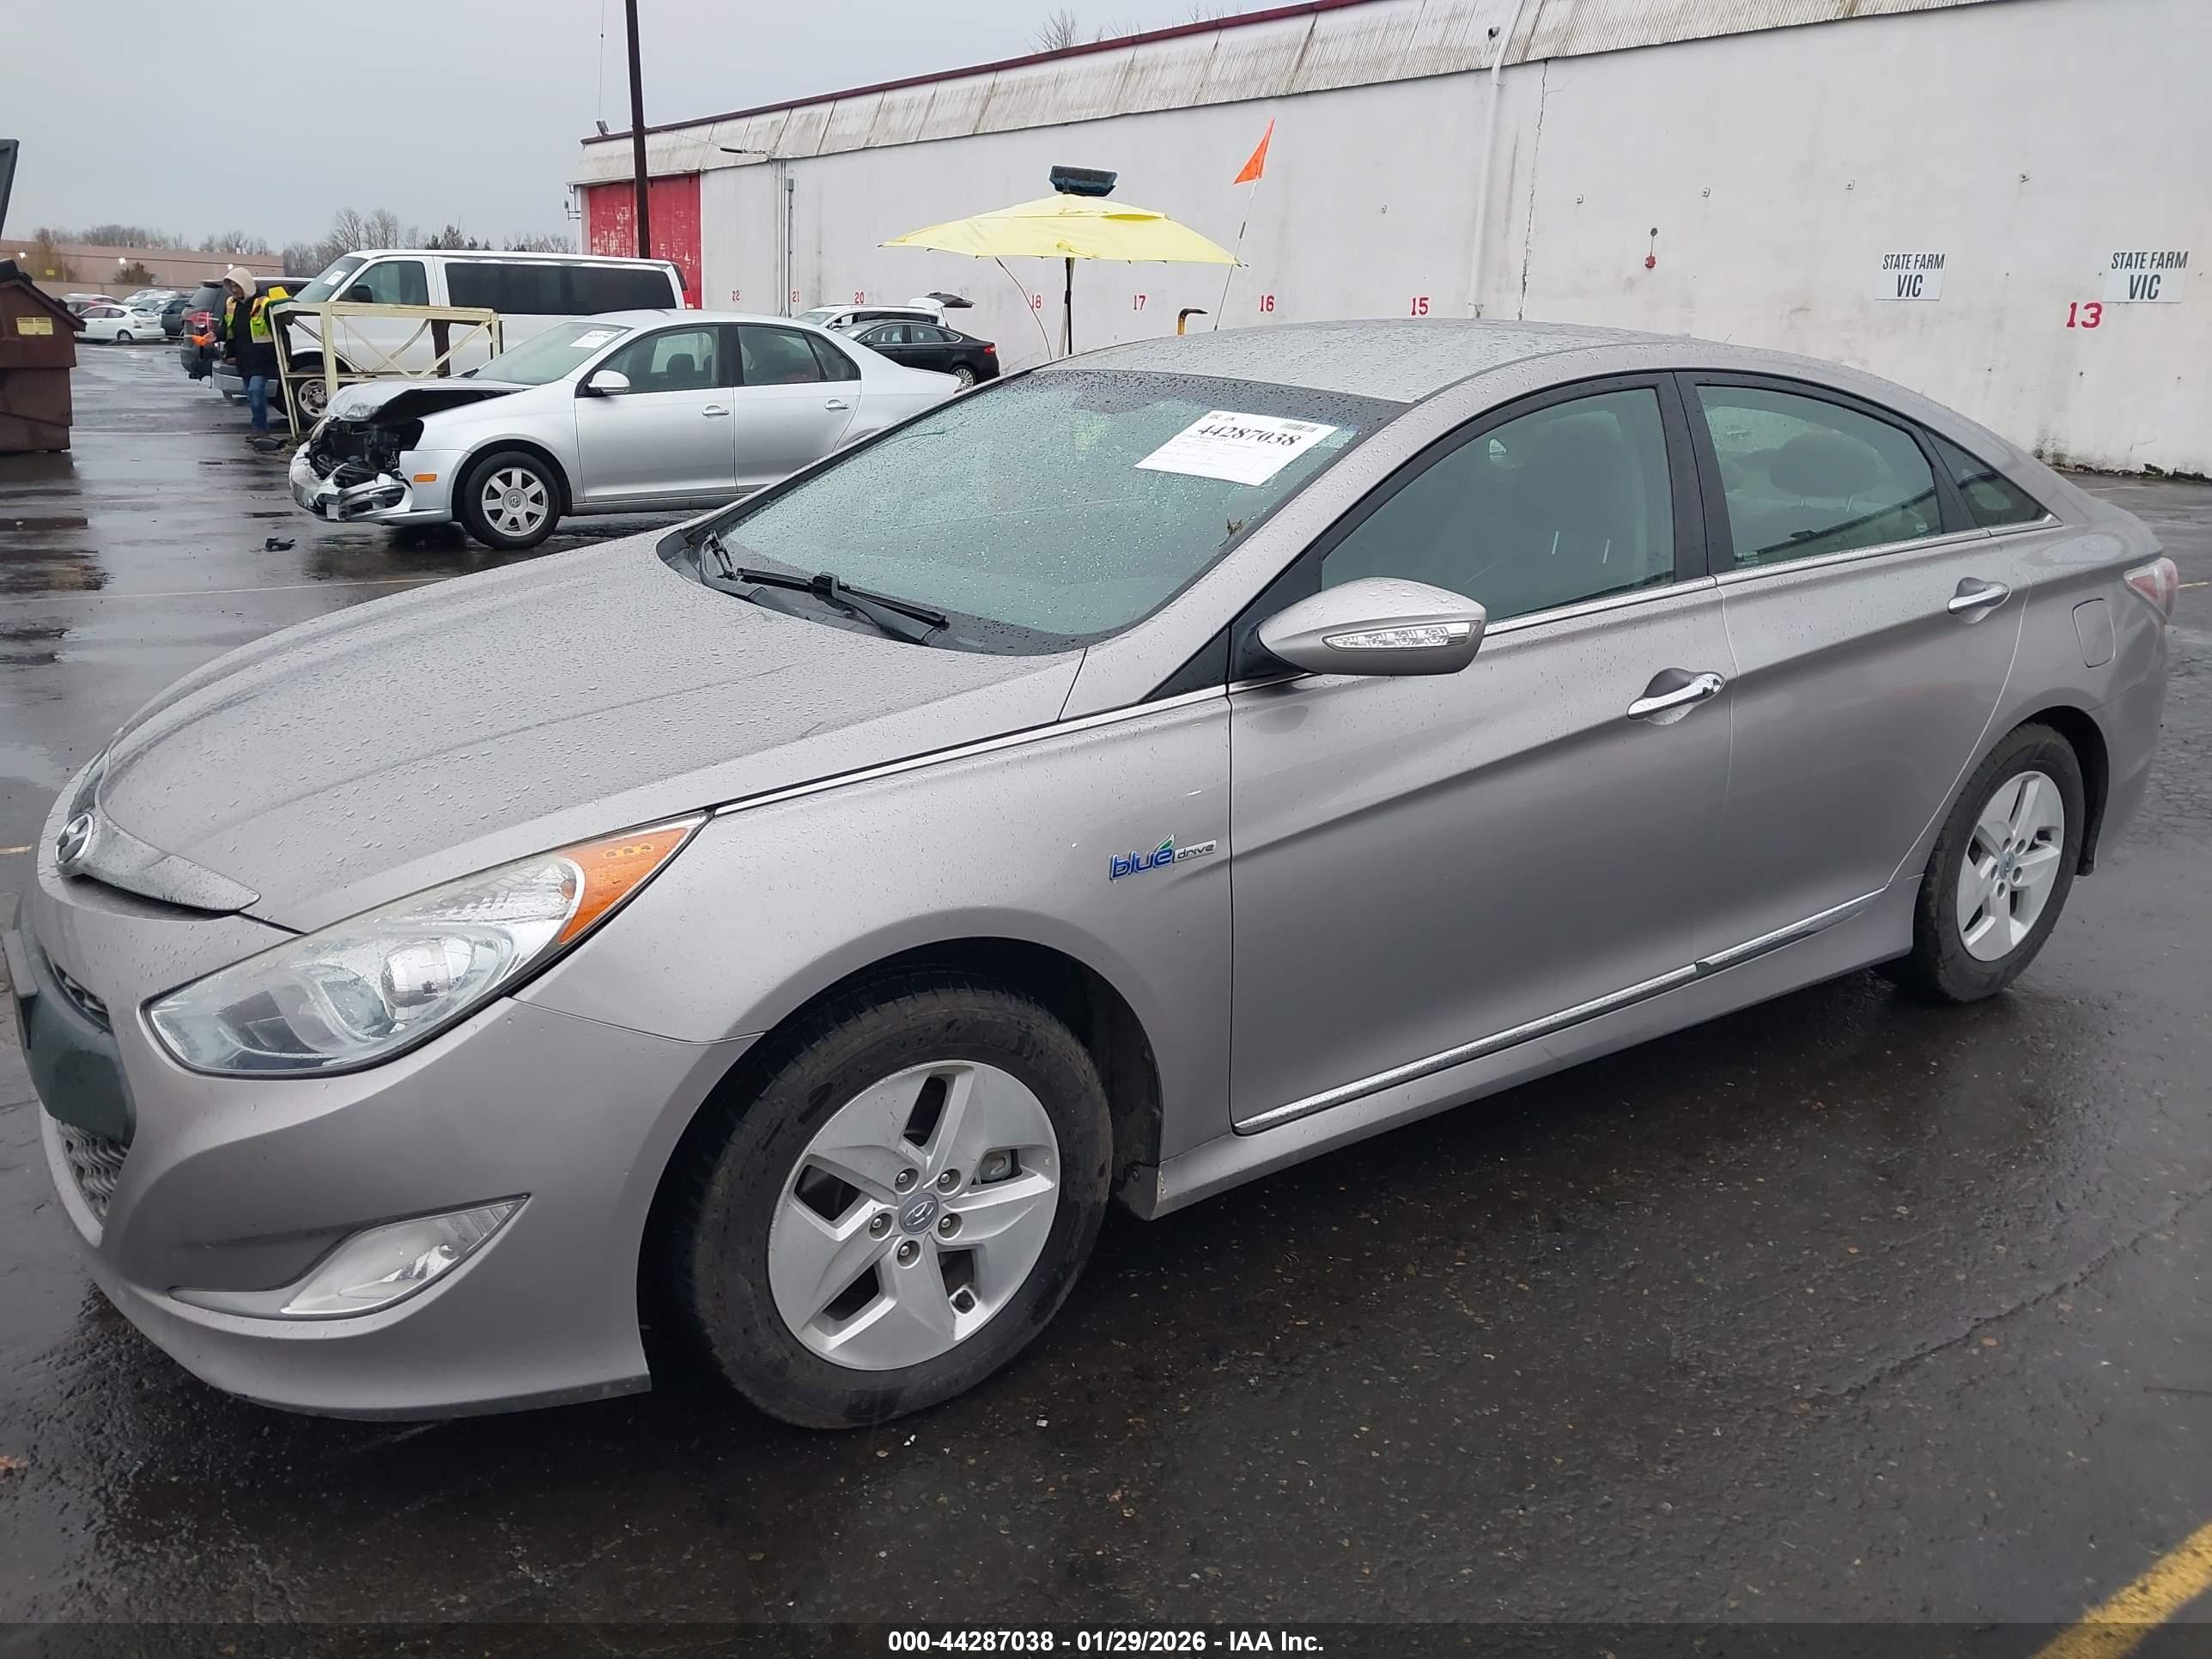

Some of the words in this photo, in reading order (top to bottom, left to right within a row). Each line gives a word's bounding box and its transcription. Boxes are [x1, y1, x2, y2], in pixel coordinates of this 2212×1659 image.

[1882, 253, 1912, 270] STATE
[1913, 253, 1946, 270] FARM
[2111, 252, 2148, 269] STATE
[2150, 251, 2189, 269] FARM
[1896, 274, 1923, 298] VIC
[2128, 274, 2161, 301] VIC
[732, 290, 741, 301] 22
[791, 290, 800, 303] 21
[854, 291, 865, 305] 20
[1030, 295, 1042, 309] 18
[1133, 294, 1146, 311] 17
[1259, 295, 1275, 313] 16
[1410, 296, 1430, 316] 15
[2065, 301, 2104, 329] 13
[1197, 423, 1302, 447] 44287038
[1109, 844, 1175, 880] blue
[1177, 842, 1215, 860] drive
